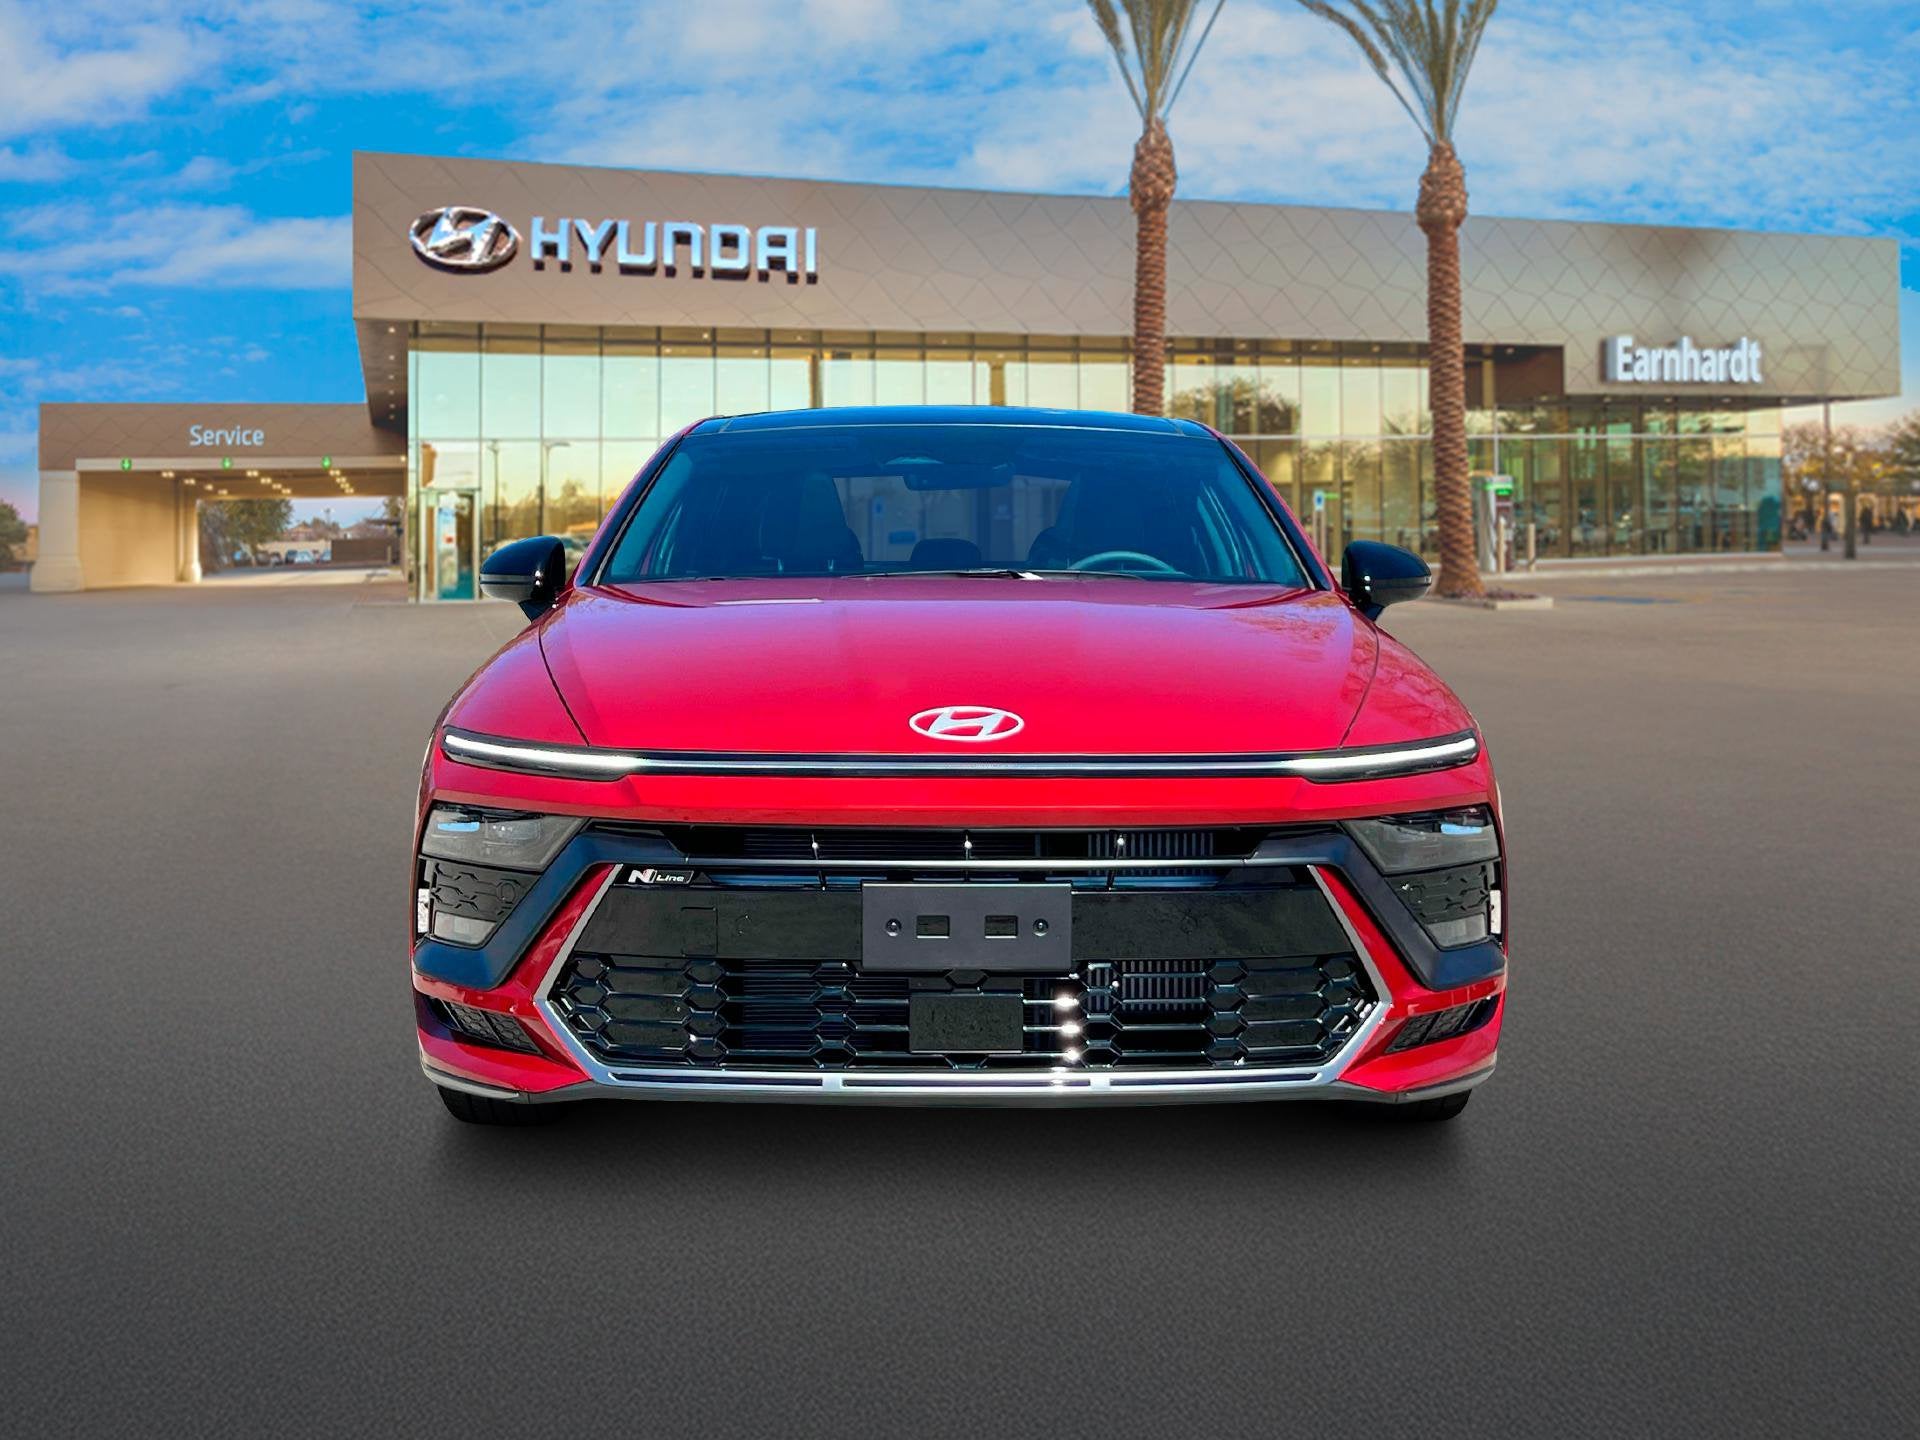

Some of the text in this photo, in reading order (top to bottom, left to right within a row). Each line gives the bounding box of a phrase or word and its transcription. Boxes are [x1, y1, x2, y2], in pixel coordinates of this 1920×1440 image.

[531, 216, 817, 281] HYUNDAI
[1606, 335, 1763, 383] Earnhardt
[189, 424, 265, 446] Service
[627, 868, 656, 884] N
